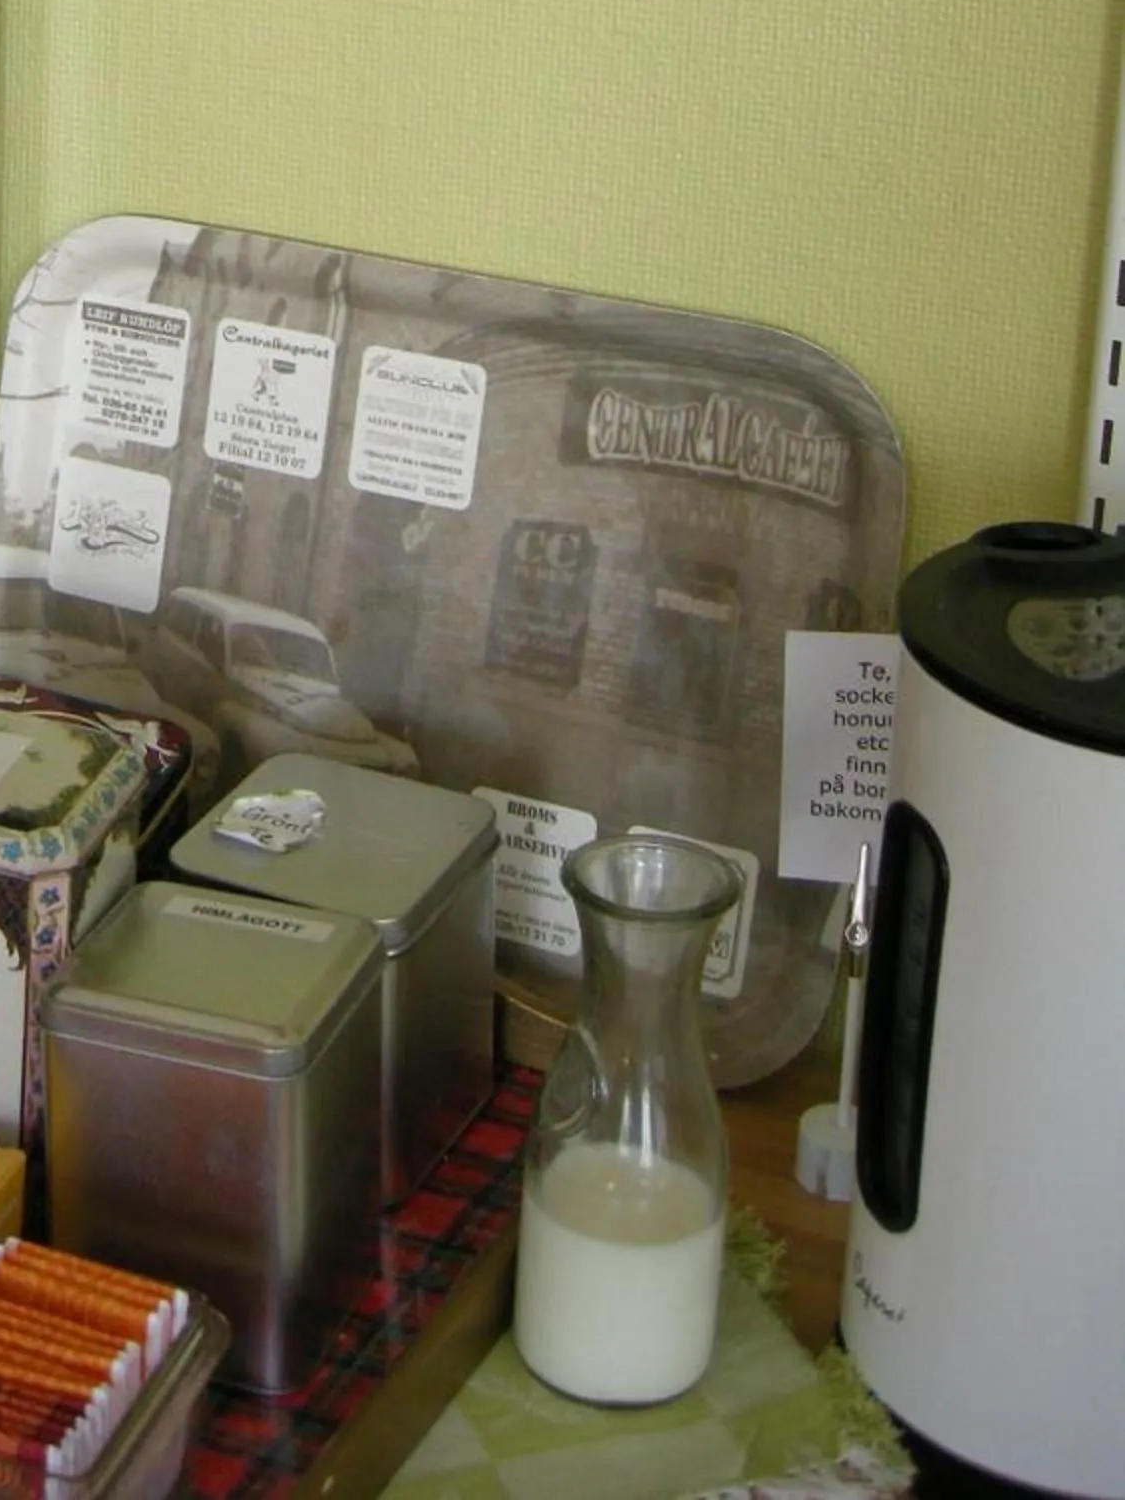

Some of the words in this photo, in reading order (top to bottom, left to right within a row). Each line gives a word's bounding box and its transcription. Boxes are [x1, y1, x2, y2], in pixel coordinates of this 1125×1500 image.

[858, 661, 892, 683] Te,
[856, 733, 890, 751] etc
[819, 773, 845, 797] på
[809, 799, 883, 821] bakom
